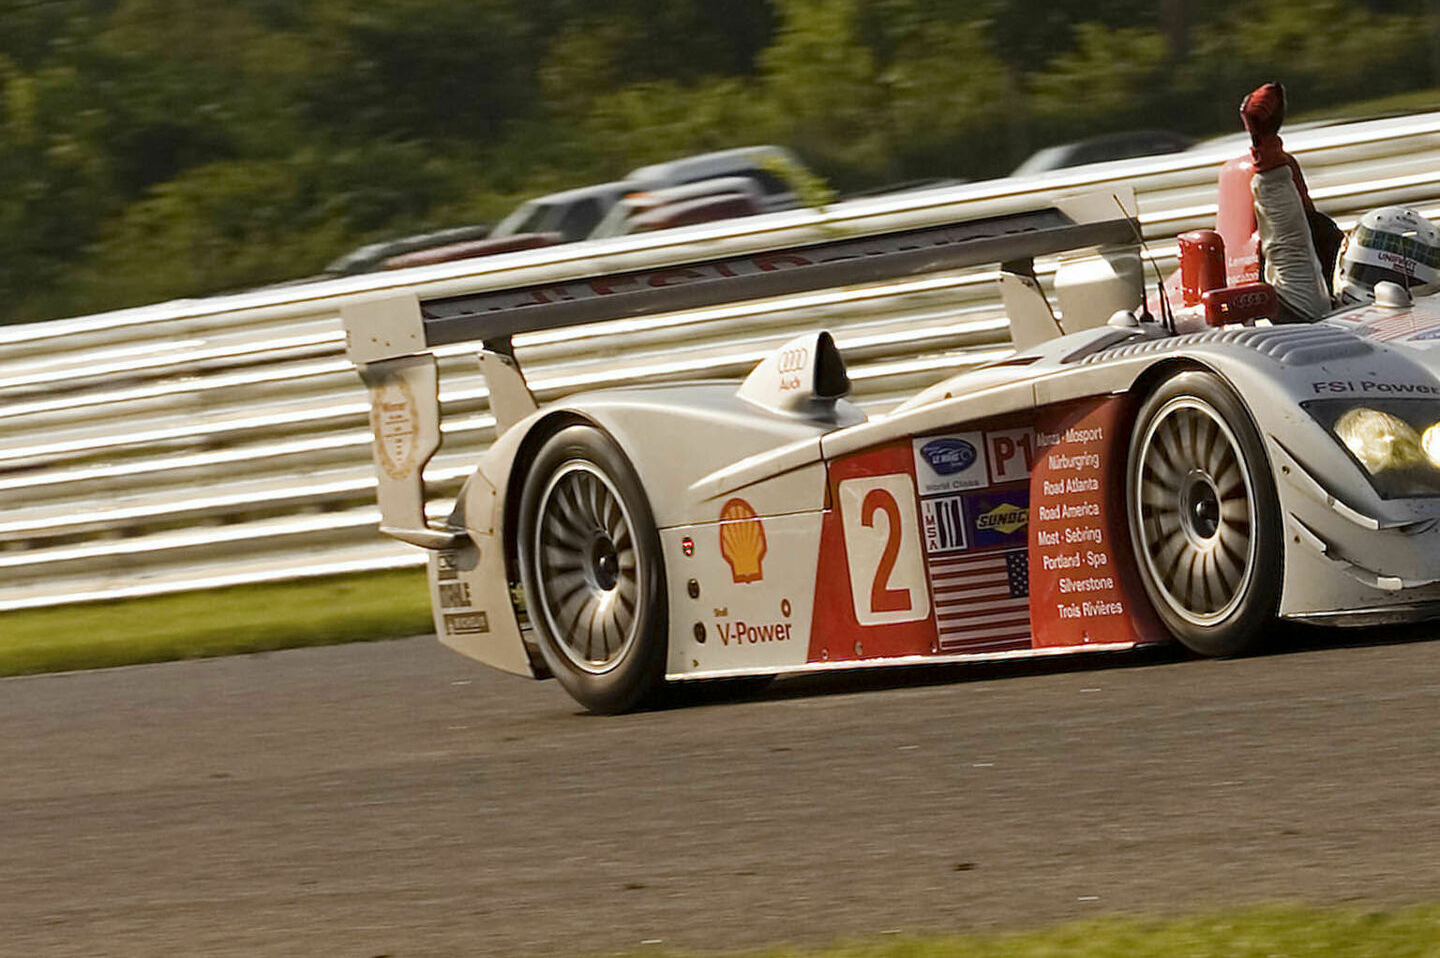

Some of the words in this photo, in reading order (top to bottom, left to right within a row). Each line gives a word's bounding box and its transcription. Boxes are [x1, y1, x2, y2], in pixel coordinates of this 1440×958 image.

[1311, 380, 1355, 394] FSI
[1360, 380, 1440, 395] Power
[1065, 426, 1104, 444] Mosport
[992, 432, 1033, 477] P1
[1047, 450, 1100, 470] Nürburgring
[1043, 478, 1065, 495] Road
[1066, 476, 1099, 493] Atlanta
[979, 511, 1029, 527] SUNOC
[1039, 504, 1061, 520] Road
[1062, 501, 1100, 519] America
[1038, 530, 1060, 546] Most
[1064, 526, 1103, 544] Sebring
[860, 488, 913, 614] 2
[1042, 551, 1081, 571] Portland
[1086, 550, 1108, 569] Spa
[1059, 576, 1115, 593] Silverstone
[1057, 602, 1081, 619] Trois
[1082, 599, 1125, 617] Rivières
[716, 621, 792, 646] V-Power
